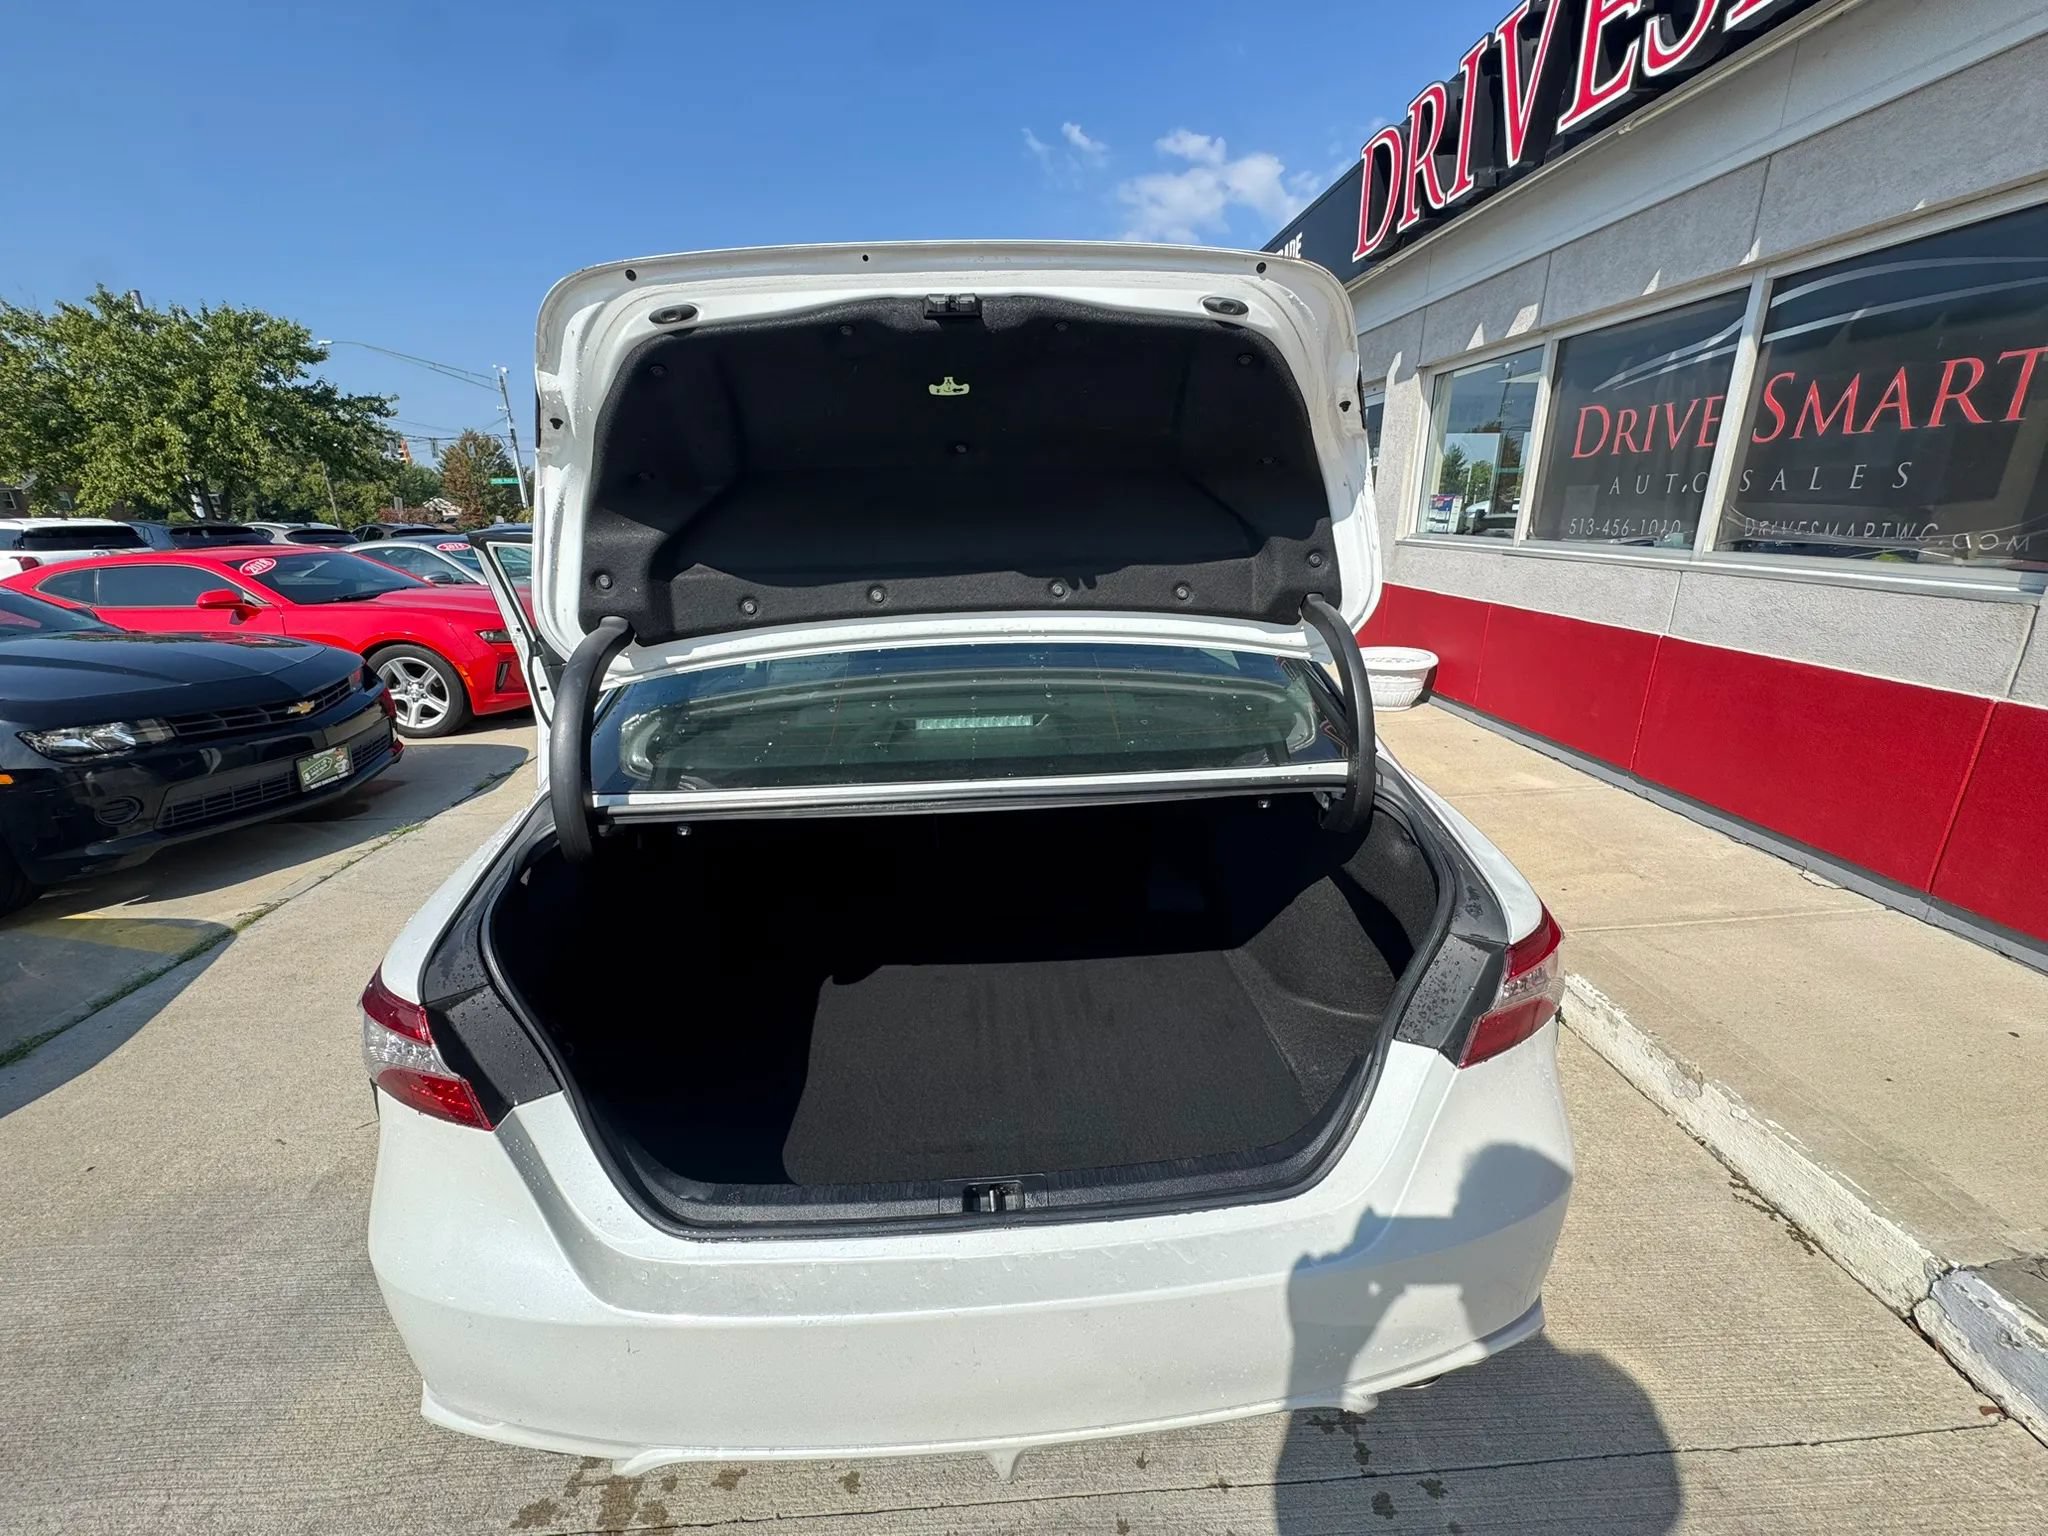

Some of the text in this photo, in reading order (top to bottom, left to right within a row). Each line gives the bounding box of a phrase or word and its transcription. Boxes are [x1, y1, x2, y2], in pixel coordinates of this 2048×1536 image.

[1352, 0, 1774, 262] DRIVE
[1571, 346, 2048, 459] DRIVE SMART
[1609, 461, 1912, 495] AUTO SALES
